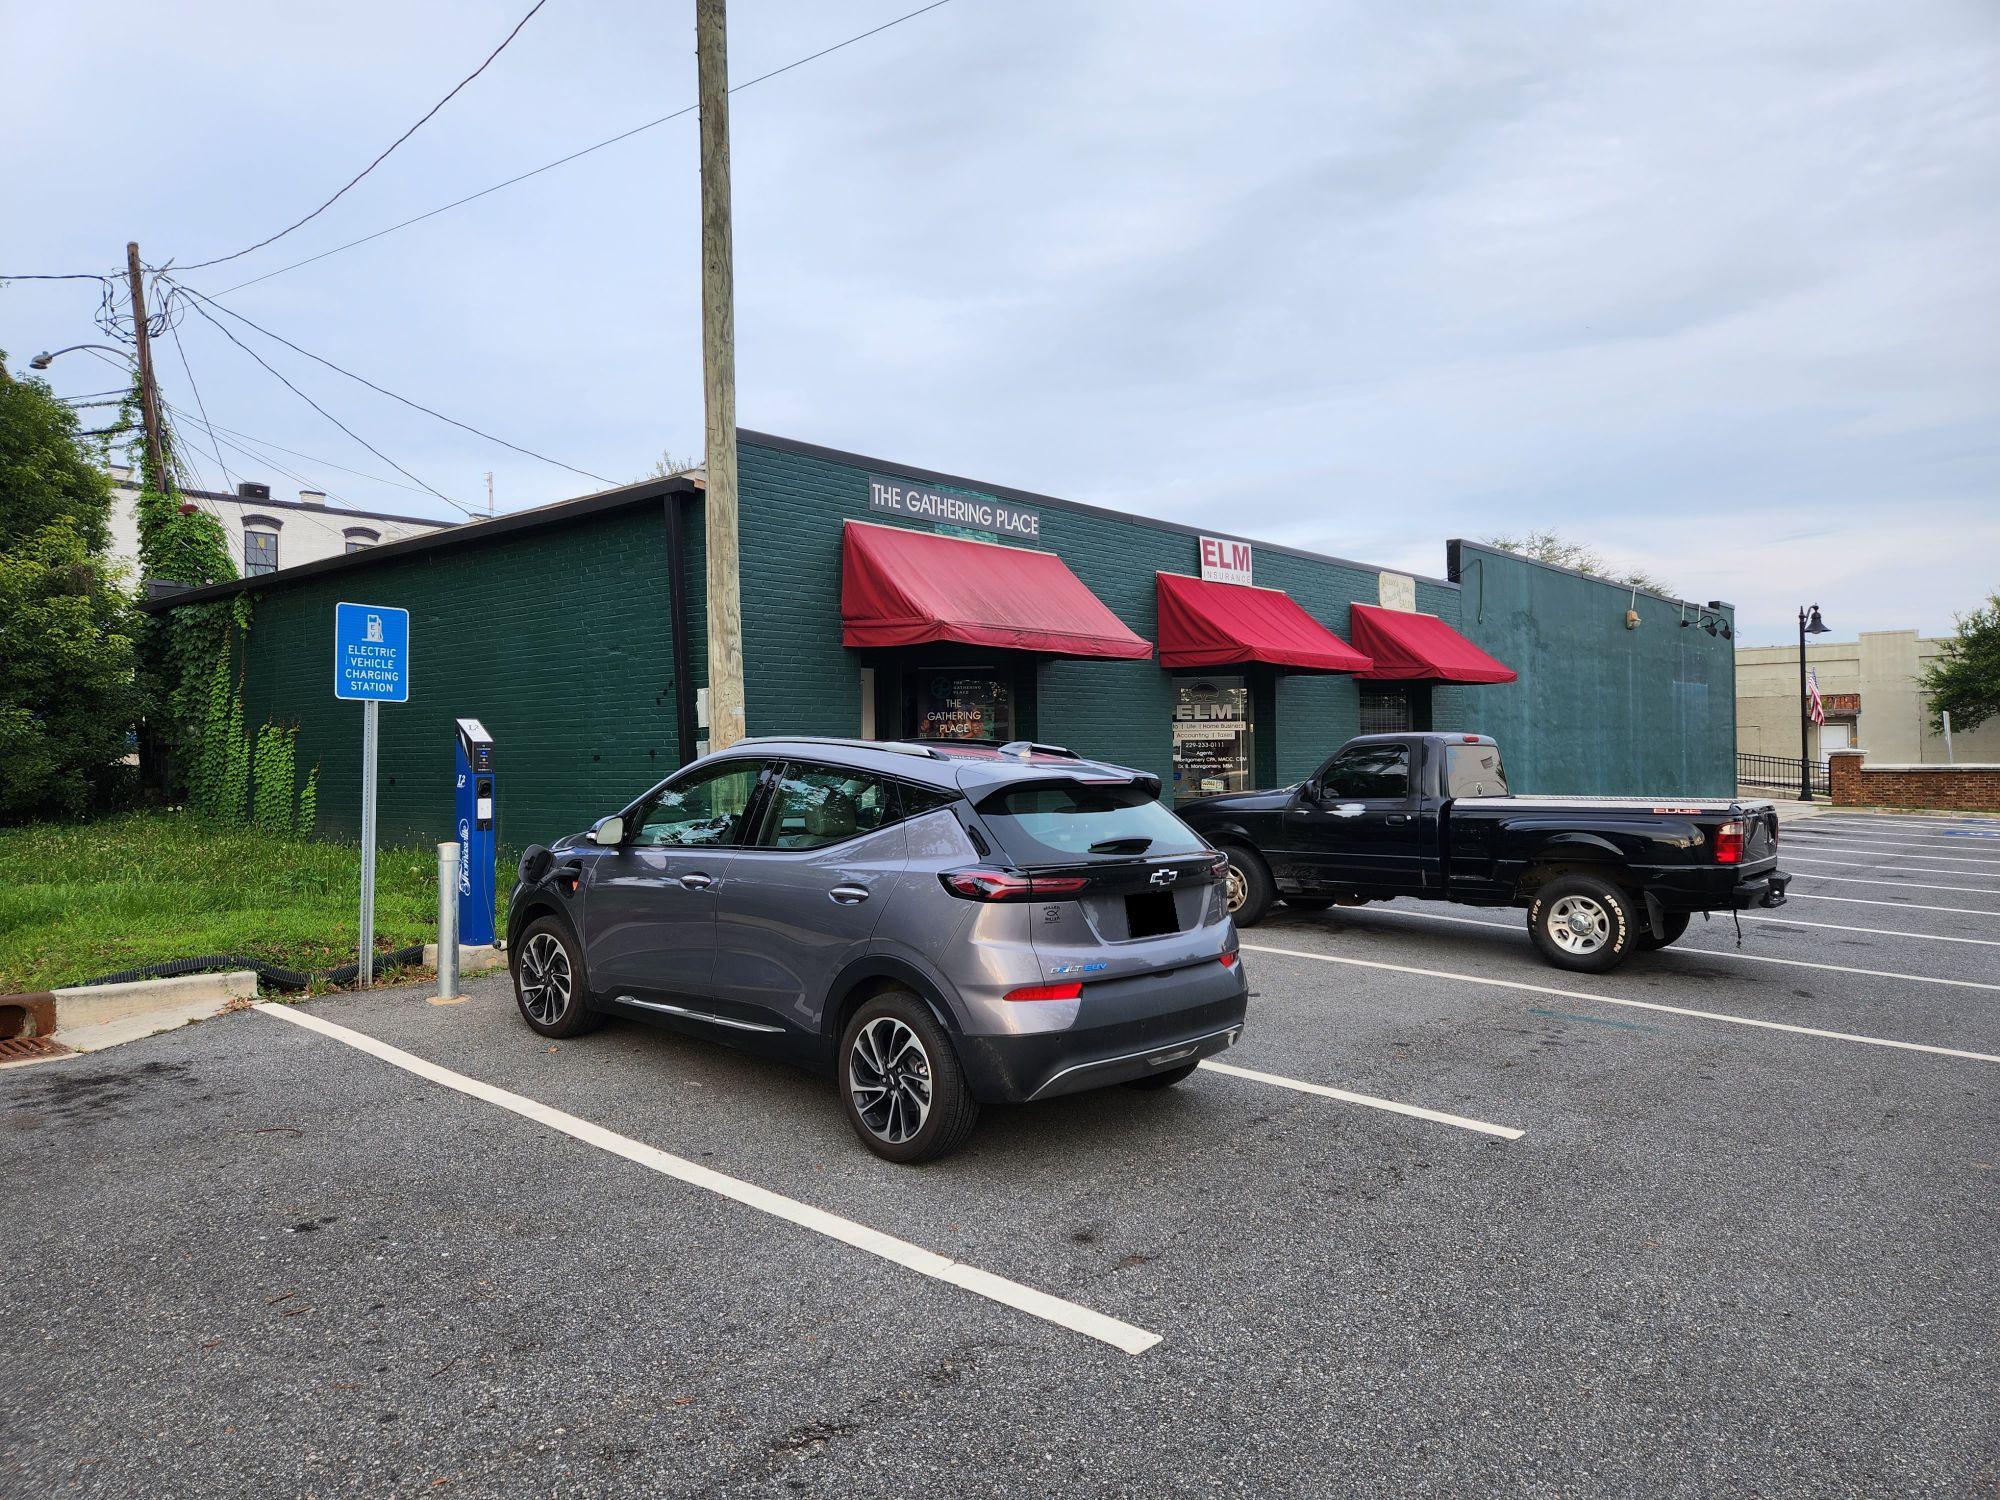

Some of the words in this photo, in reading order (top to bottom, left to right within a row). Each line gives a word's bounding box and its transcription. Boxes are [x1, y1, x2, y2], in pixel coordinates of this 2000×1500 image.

[872, 483, 901, 509] THE
[906, 491, 992, 526] GATHERING
[996, 509, 1040, 535] PLACE
[1202, 539, 1250, 572] ELM
[1203, 569, 1251, 584] INSURANCE
[348, 645, 397, 658] ELECTRIC
[351, 657, 394, 669] VEHICLE
[345, 669, 399, 681] CHARGING
[350, 681, 393, 692] STATION
[945, 699, 962, 708] THE
[927, 711, 981, 721] GATHERING
[1176, 704, 1233, 719] ELM
[939, 723, 970, 733] PLACE
[456, 774, 466, 786] L2
[1604, 894, 1626, 954] IRONMAN
[1084, 962, 1108, 972] EUV
